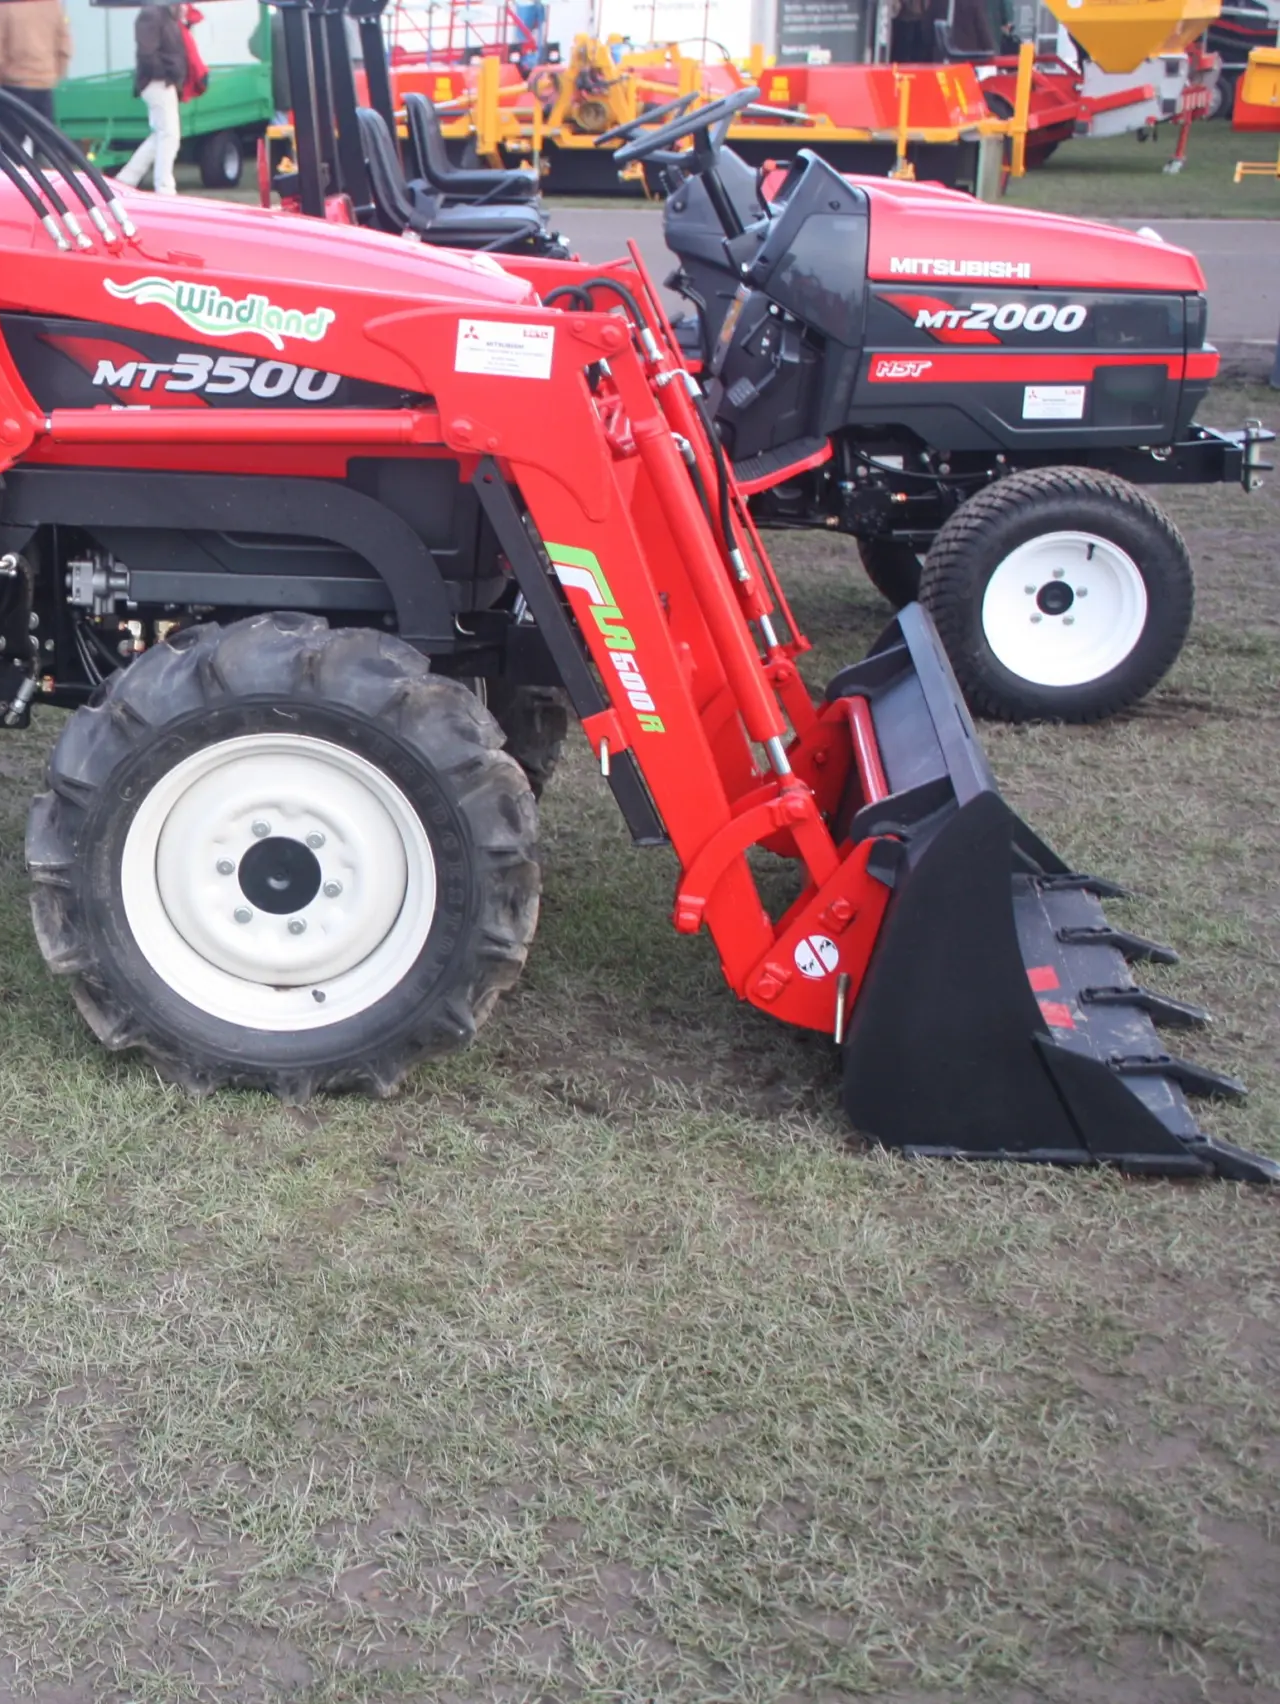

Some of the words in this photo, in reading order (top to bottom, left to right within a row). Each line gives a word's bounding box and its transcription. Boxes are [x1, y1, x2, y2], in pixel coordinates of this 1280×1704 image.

[890, 257, 1031, 279] MITSUBISHI
[175, 283, 328, 337] Windland
[915, 303, 1088, 332] MT2000
[92, 353, 342, 401] MT3500
[875, 360, 932, 378] HST
